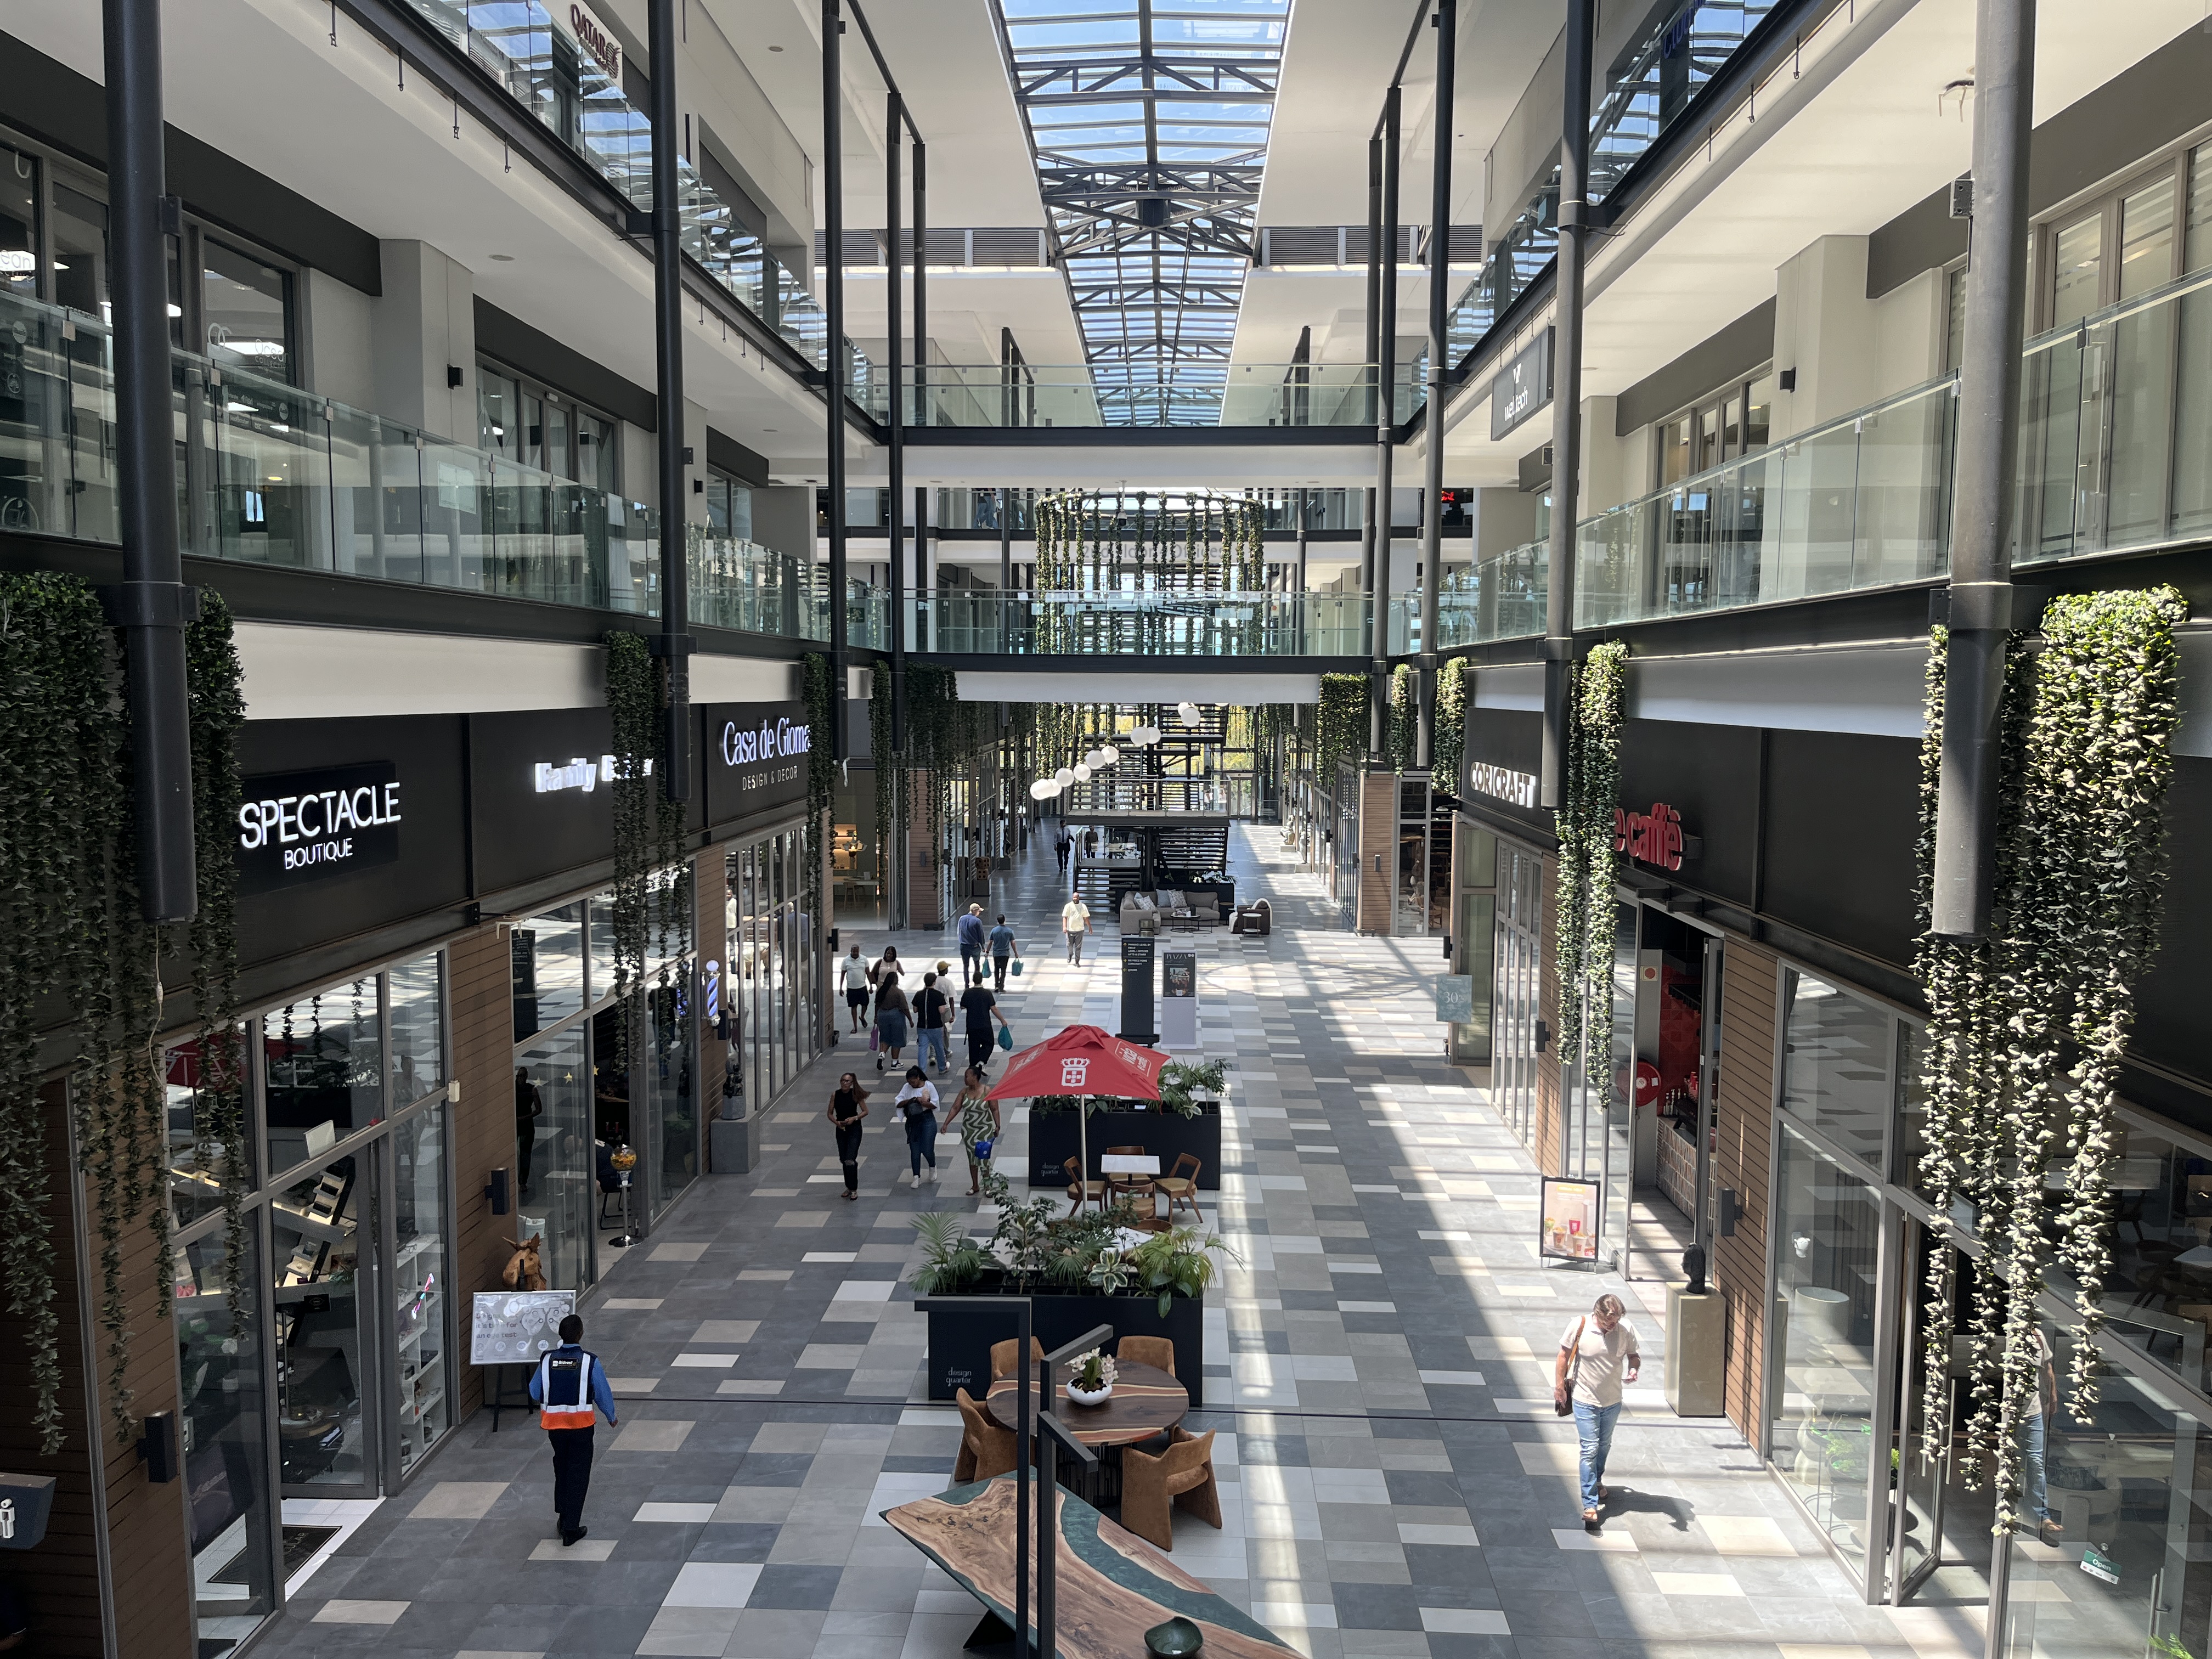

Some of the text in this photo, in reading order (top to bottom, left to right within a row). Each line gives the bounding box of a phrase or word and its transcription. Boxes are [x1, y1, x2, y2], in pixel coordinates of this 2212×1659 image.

[571, 4, 607, 61] QATAR
[724, 721, 757, 766] Casa
[760, 719, 775, 760] de
[535, 758, 597, 792] Family
[742, 765, 798, 791] DESIGN & DECOR
[1470, 761, 1536, 808] CORICRAFT
[239, 782, 401, 848] SPECTACLE
[285, 838, 353, 870] BOUTIQUE
[946, 1377, 972, 1387] quarter
[948, 1367, 972, 1377] design
[2092, 1559, 2112, 1571] Open
